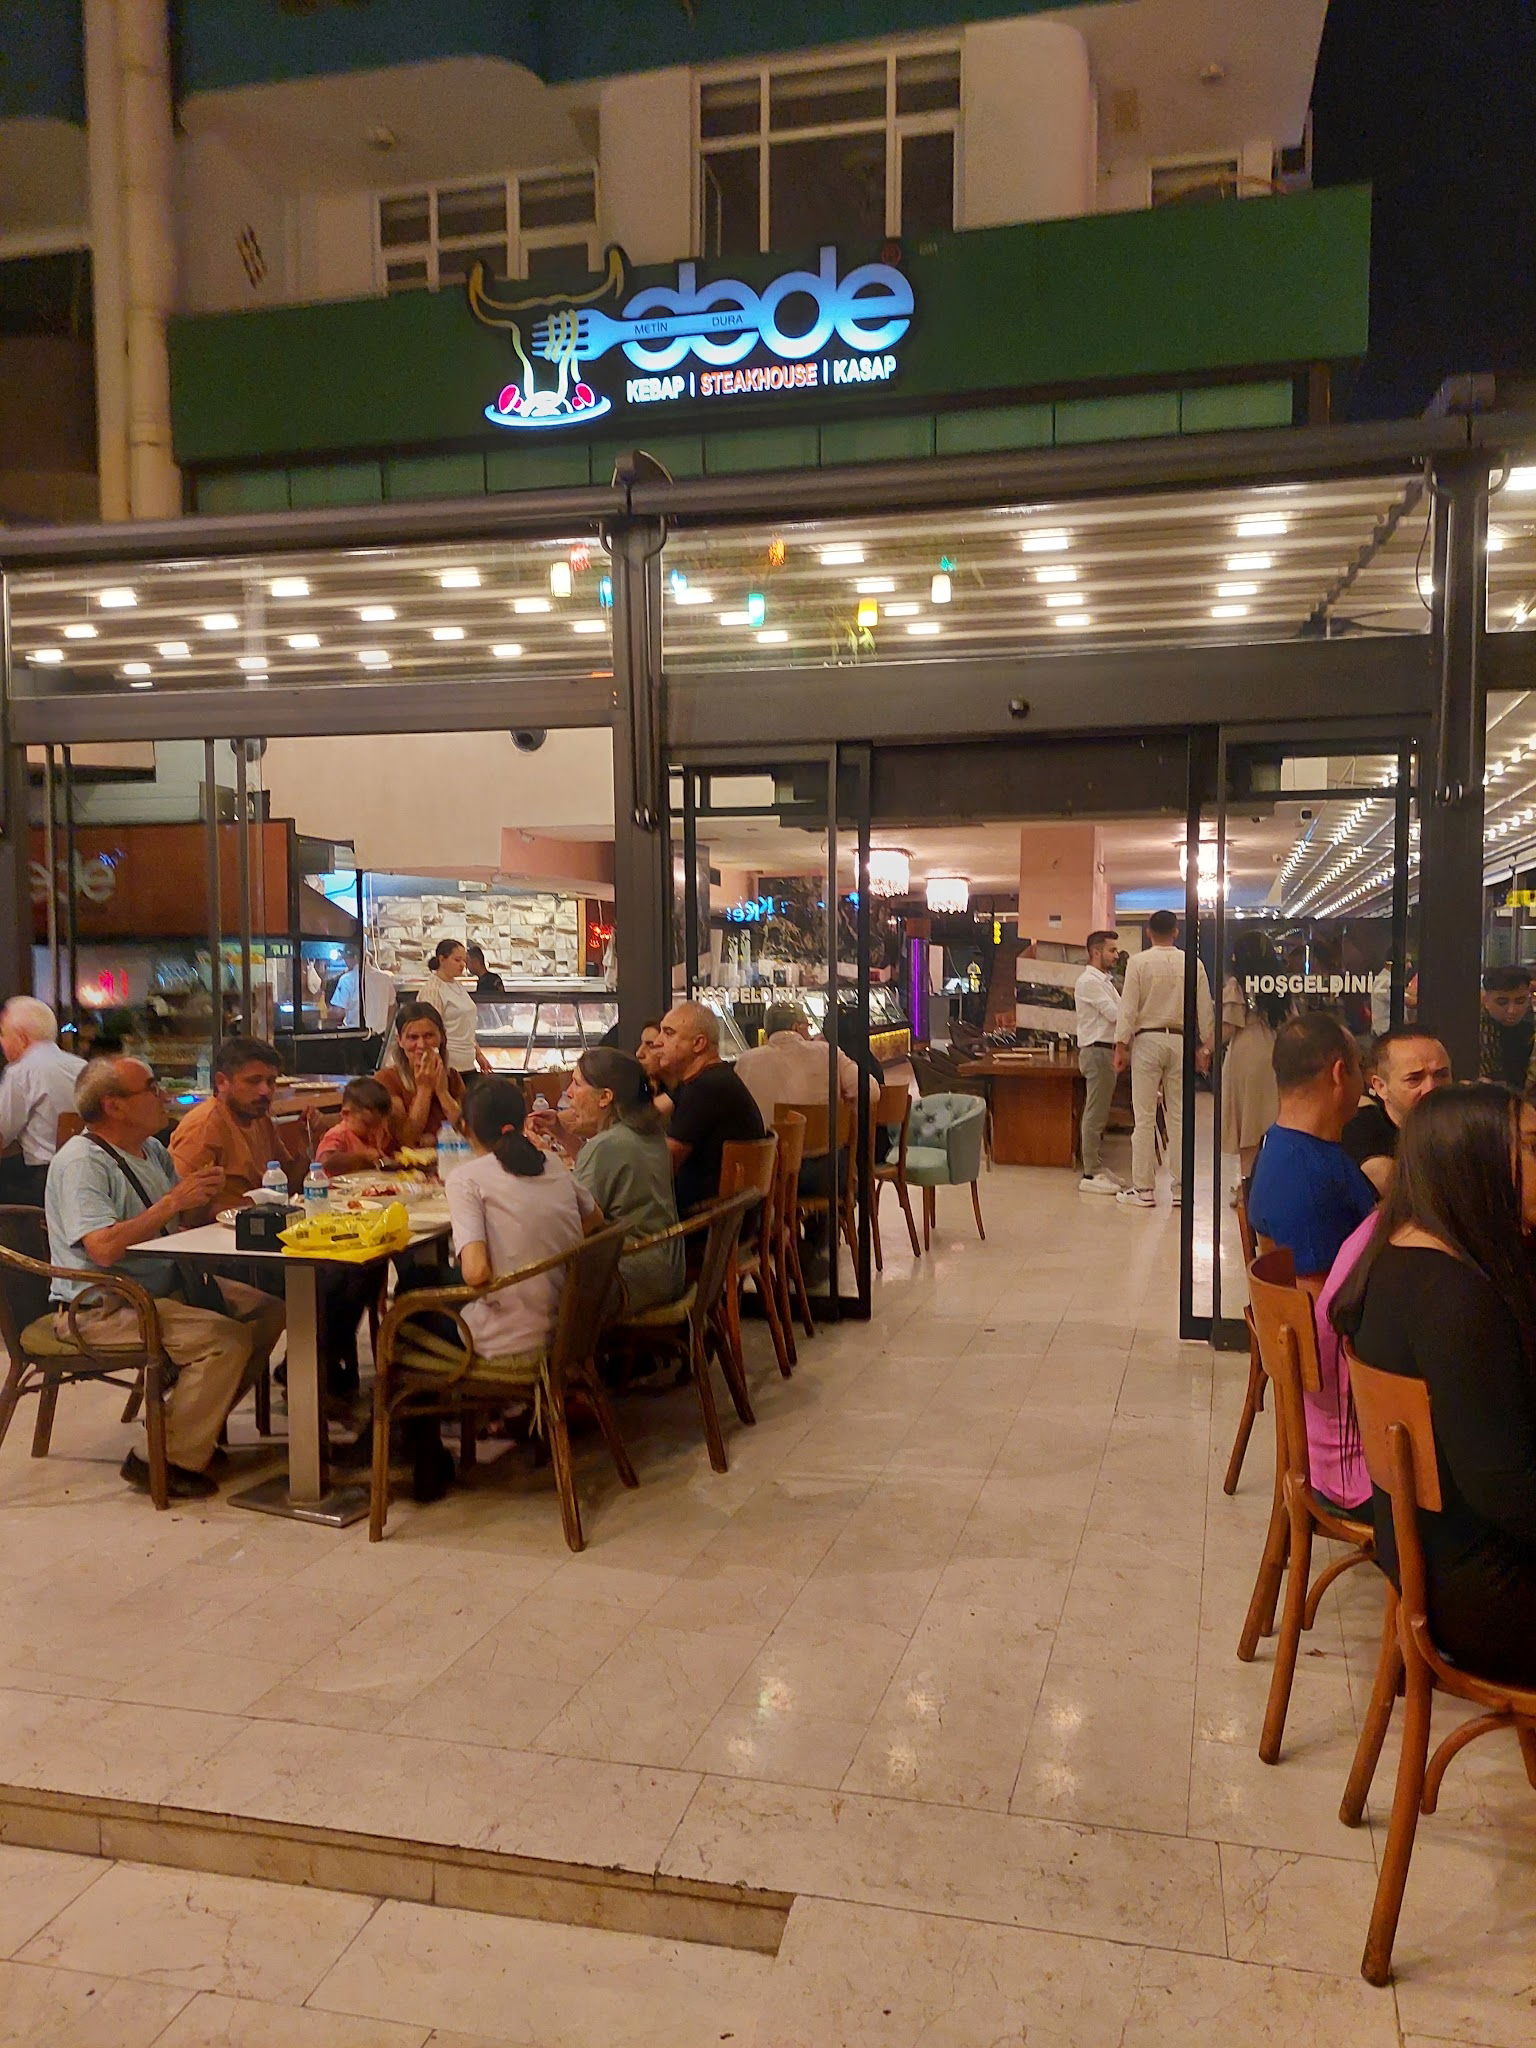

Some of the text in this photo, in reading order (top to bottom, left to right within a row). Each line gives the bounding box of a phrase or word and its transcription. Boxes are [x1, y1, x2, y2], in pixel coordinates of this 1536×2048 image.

[712, 314, 744, 327] DURA
[626, 355, 897, 404] KEBAP STEAKHOUSE KASAP
[1245, 970, 1389, 998] HOŞGELDİNİZ
